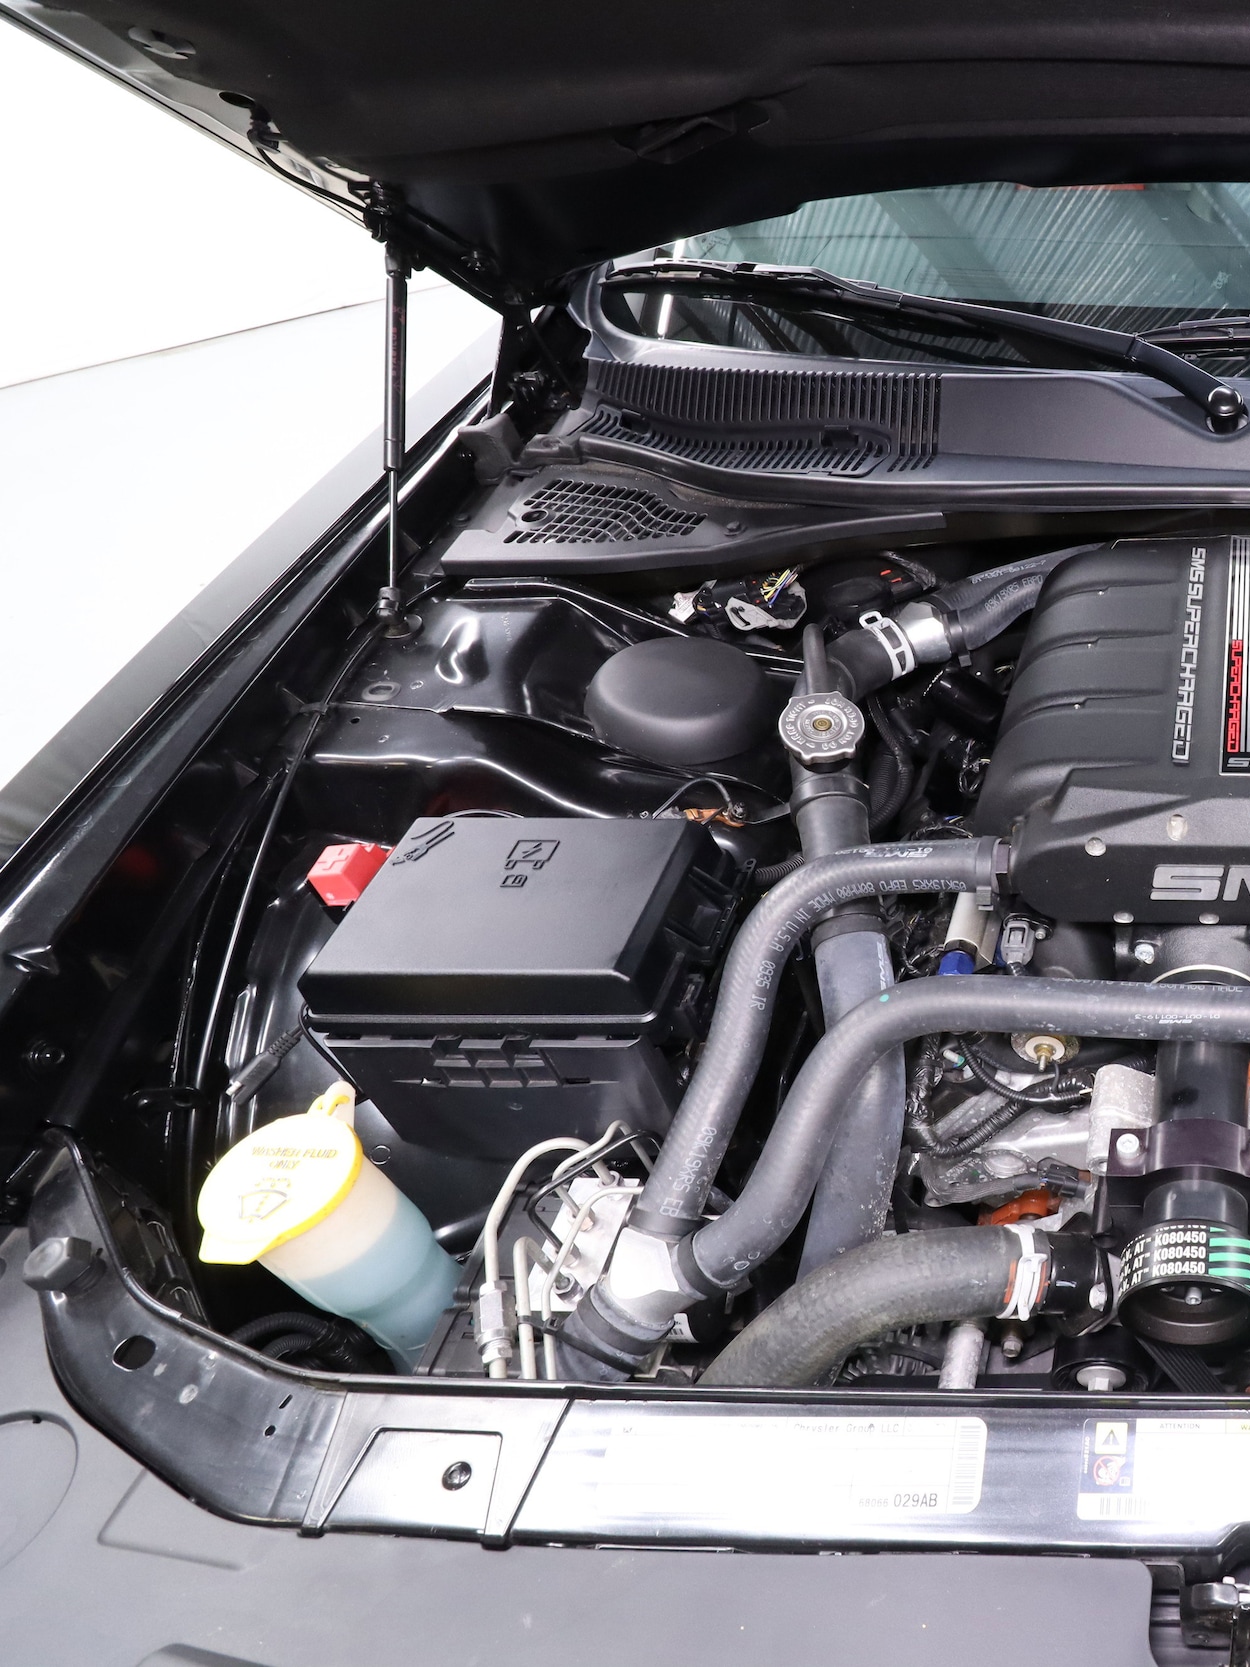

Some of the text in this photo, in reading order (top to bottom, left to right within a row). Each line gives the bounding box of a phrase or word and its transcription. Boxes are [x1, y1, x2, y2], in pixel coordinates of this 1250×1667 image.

[1226, 639, 1243, 753] SUPERCHARGED
[807, 889, 836, 914] MADE
[793, 906, 812, 923] IN
[302, 1148, 339, 1159] FLUID
[1154, 1231, 1207, 1246] K080450
[1153, 1246, 1206, 1262] K080450
[1152, 1261, 1206, 1277] K080450
[793, 1423, 840, 1435] Chrysler
[881, 1423, 900, 1433] LLC
[1159, 1422, 1201, 1430] ATTENTION
[893, 1493, 938, 1508] 029AB
